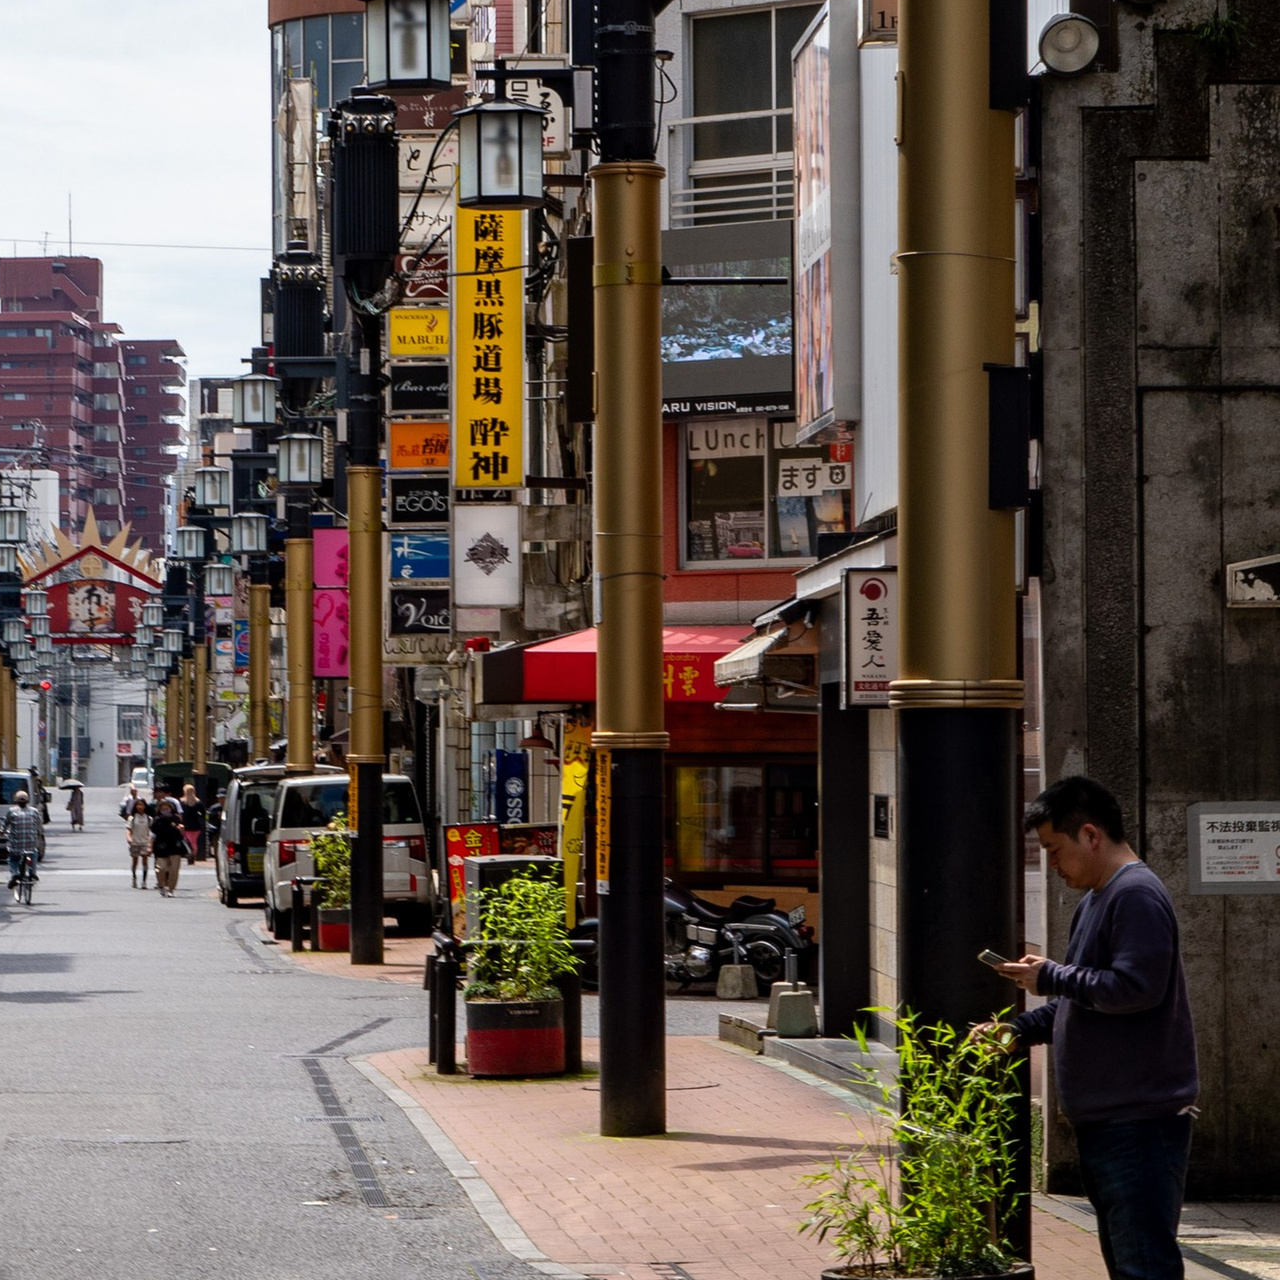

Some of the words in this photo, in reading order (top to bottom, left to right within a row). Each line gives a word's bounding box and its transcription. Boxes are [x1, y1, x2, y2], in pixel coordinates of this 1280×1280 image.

[471, 212, 505, 406] 薩摩黒豚道場
[694, 401, 737, 411] VISION
[468, 416, 510, 482] 酔神
[781, 465, 822, 491] ます
[861, 607, 886, 668] 吾愛人
